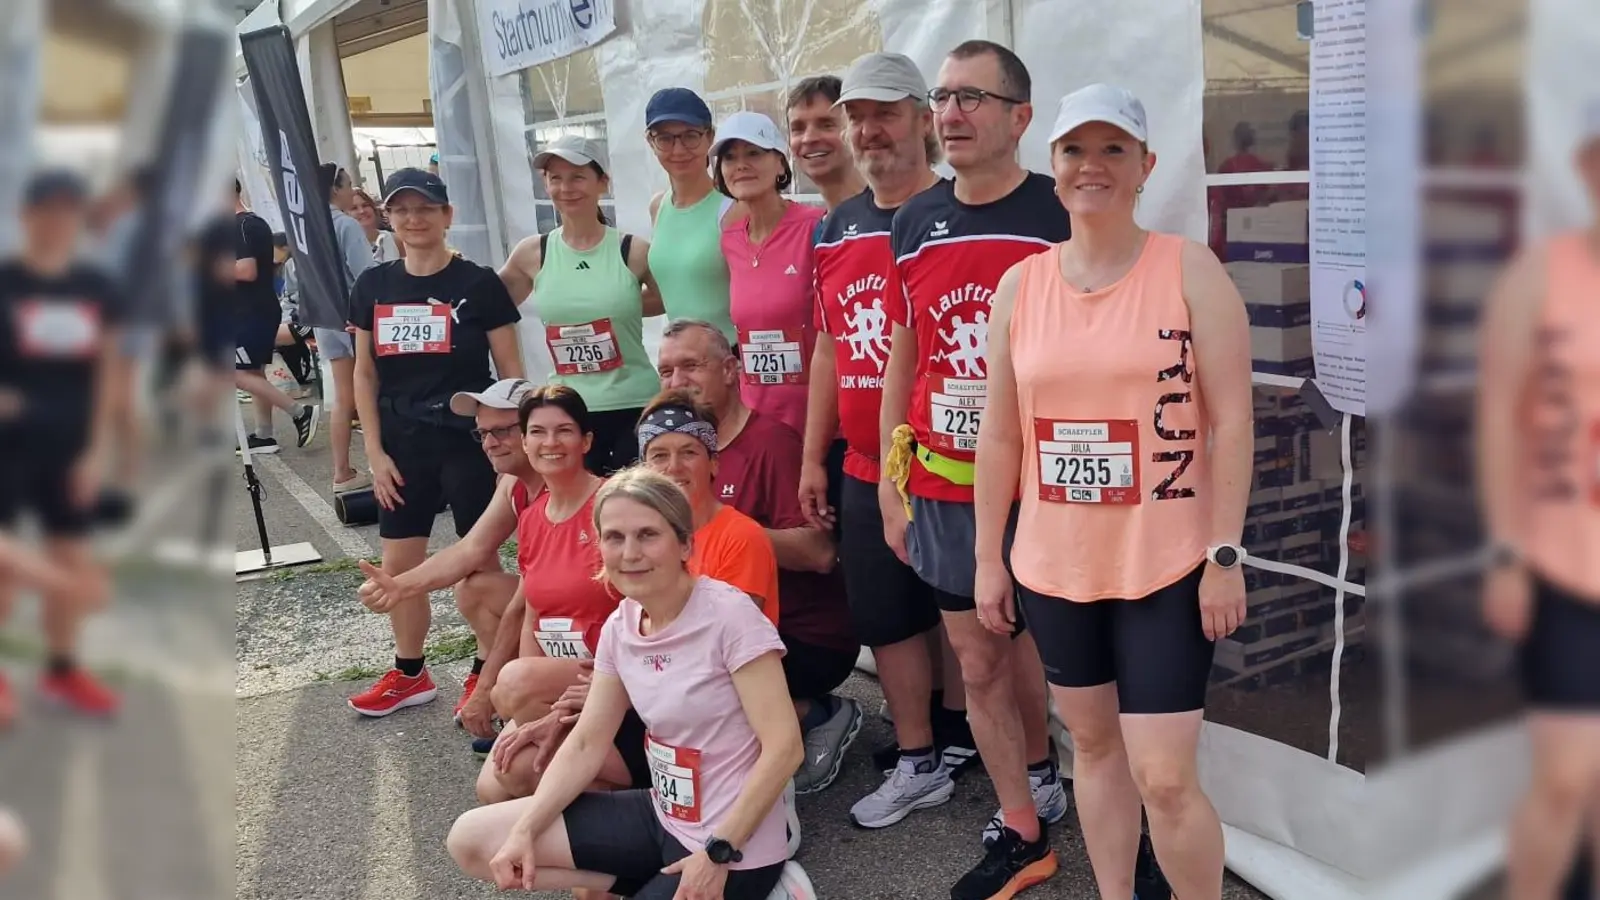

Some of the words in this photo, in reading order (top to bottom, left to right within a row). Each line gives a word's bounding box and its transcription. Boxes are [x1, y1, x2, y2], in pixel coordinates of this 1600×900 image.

[392, 325, 431, 342] 2249
[566, 344, 603, 362] 2256
[752, 353, 786, 372] 2251
[959, 398, 976, 406] ALEX
[945, 409, 980, 435] 225
[1151, 329, 1196, 500] RUN
[1071, 443, 1091, 453] JULIA
[1056, 457, 1111, 485] 2255
[546, 641, 578, 658] 2244
[655, 772, 678, 801] 34
